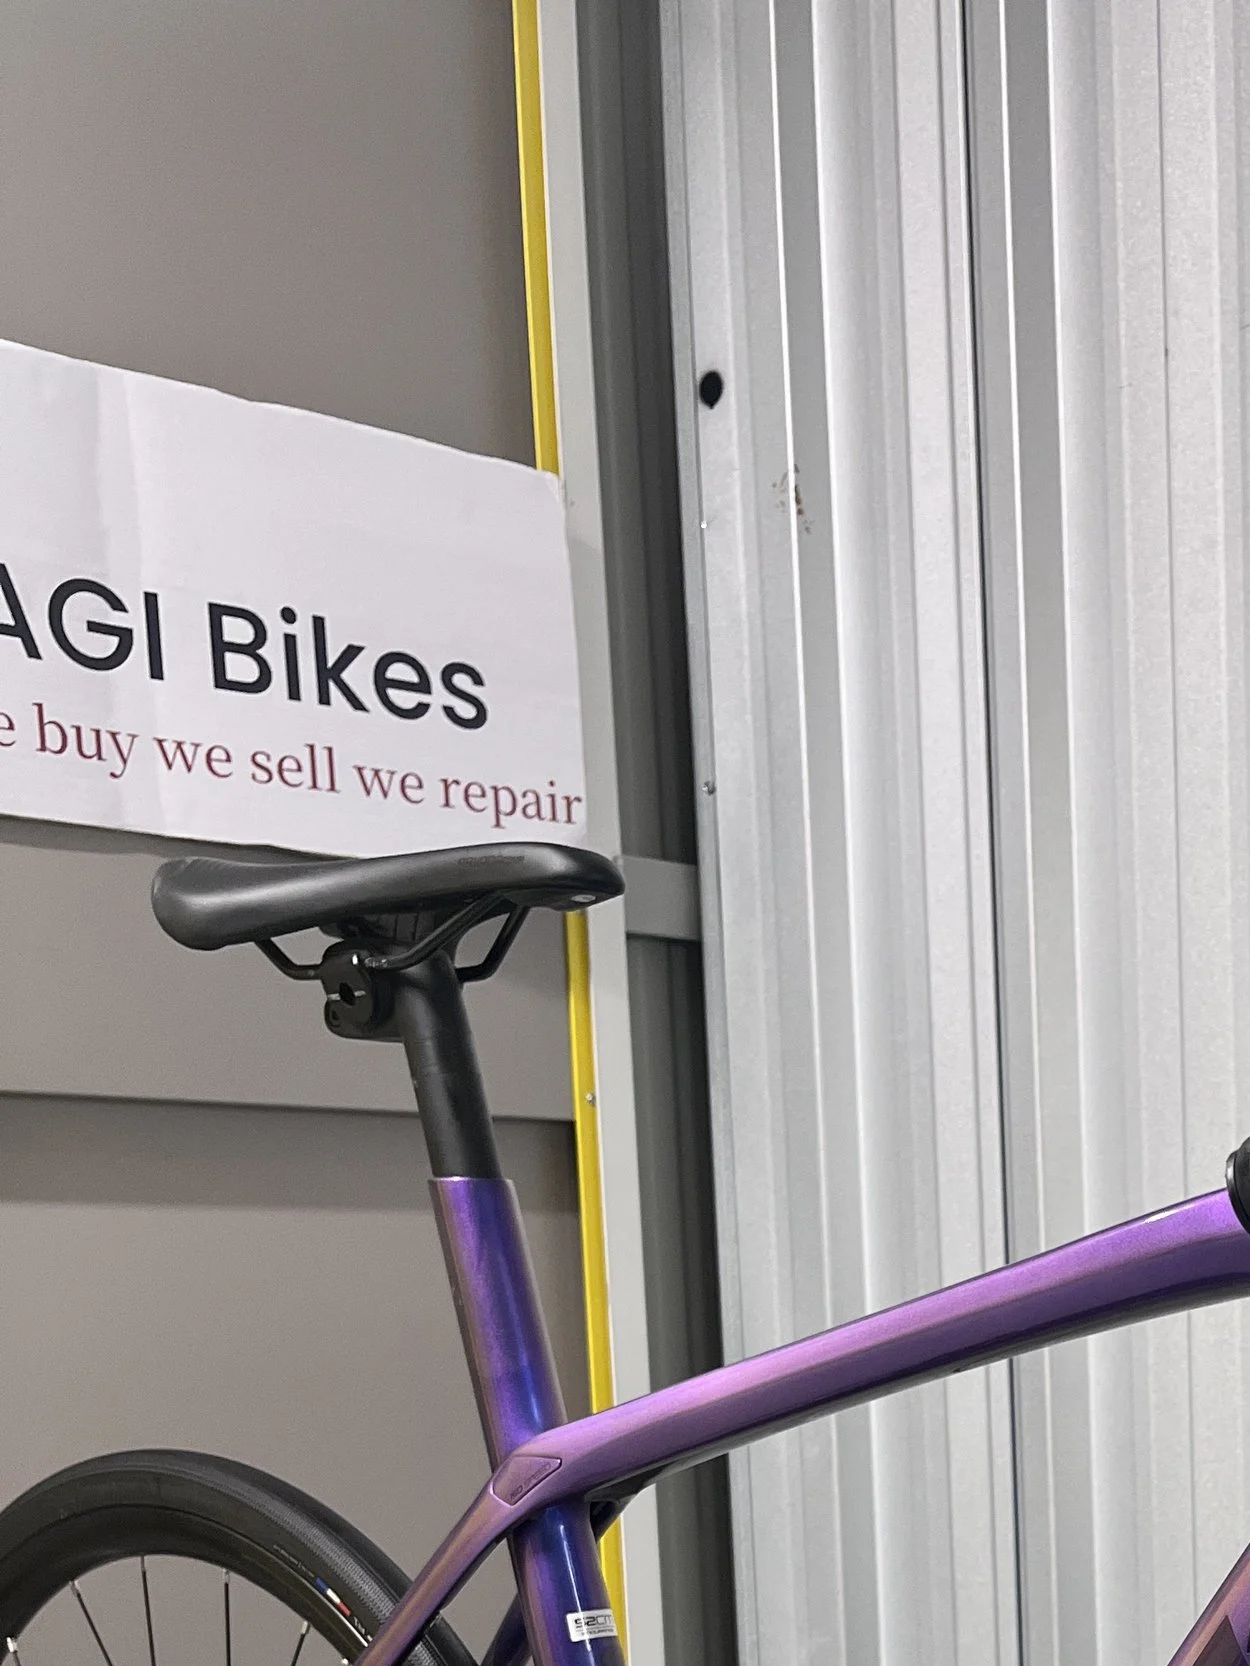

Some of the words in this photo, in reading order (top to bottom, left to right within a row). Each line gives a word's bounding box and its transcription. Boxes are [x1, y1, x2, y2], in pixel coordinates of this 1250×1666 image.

[207, 601, 489, 731] Bikes
[33, 702, 139, 779] buy
[153, 736, 234, 779] we
[250, 743, 340, 794] sell
[352, 764, 425, 805] we
[440, 778, 583, 830] repair
